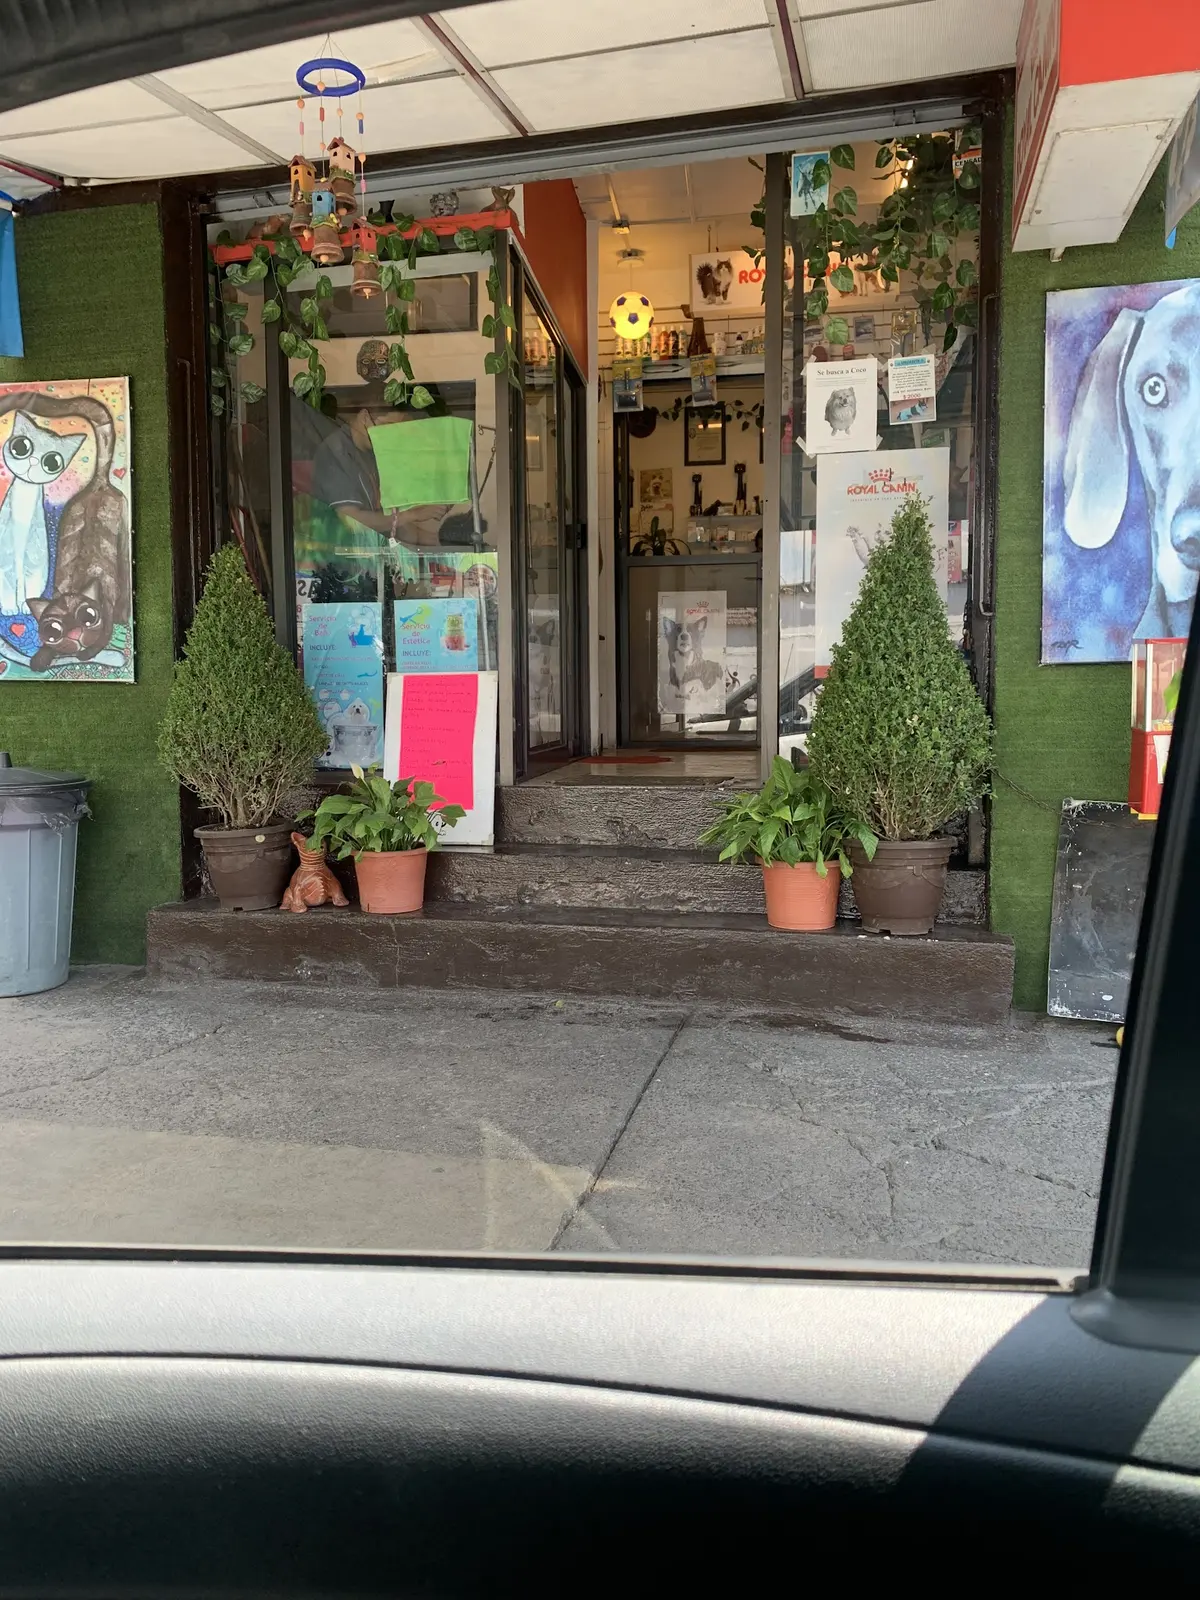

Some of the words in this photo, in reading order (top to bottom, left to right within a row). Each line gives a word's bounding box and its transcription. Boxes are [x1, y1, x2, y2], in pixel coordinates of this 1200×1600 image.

[847, 485, 879, 496] ROYAL
[881, 482, 916, 493] CANIN
[402, 649, 432, 657] INCLUYE:
